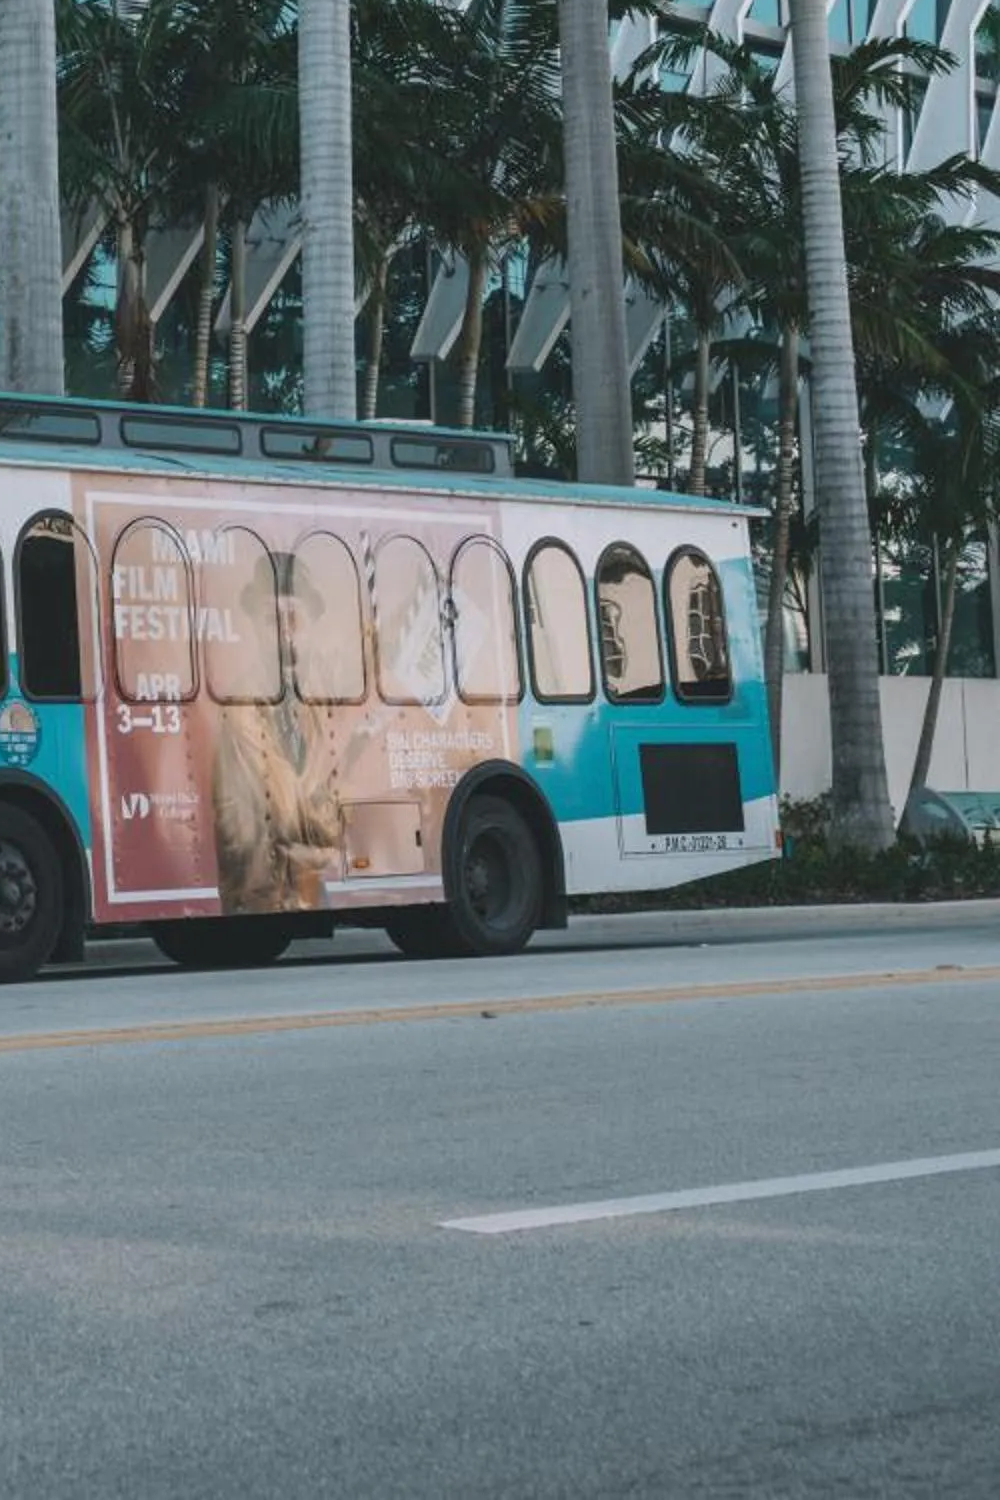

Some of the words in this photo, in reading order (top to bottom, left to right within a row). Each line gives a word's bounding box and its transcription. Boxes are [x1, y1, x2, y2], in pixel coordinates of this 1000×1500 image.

[152, 528, 235, 565] MIAMI
[113, 564, 178, 602] FILM
[115, 604, 240, 644] FESTIVAL
[135, 673, 182, 701] APR
